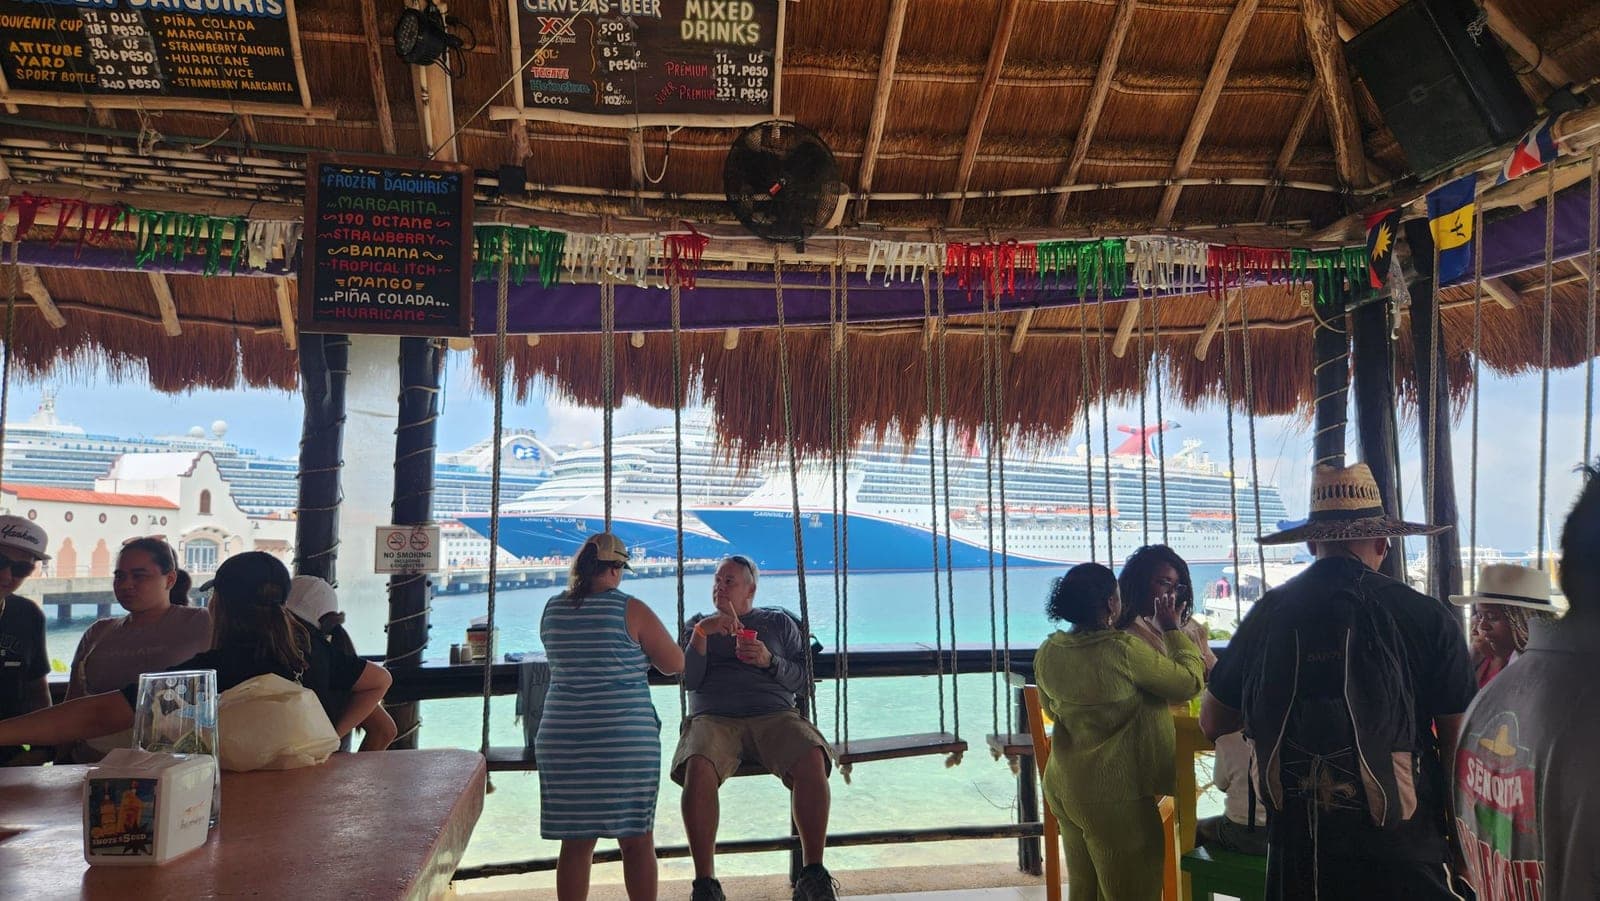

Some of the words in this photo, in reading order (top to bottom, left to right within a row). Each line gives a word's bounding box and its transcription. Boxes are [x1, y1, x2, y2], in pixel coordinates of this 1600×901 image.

[685, 0, 754, 20] MIXED
[0, 15, 56, 30] OUVENIR
[60, 19, 84, 32] CUP
[163, 14, 196, 28] PIÑA
[202, 18, 256, 31] COLADA
[537, 17, 576, 35] XX
[167, 29, 247, 42] MARGARITA
[617, 33, 631, 42] US
[681, 20, 760, 44] DRINKS
[122, 39, 139, 49] US
[168, 41, 238, 54] STRAWBERRY
[240, 46, 285, 57] DAIQUIRI
[92, 49, 119, 60] 306
[171, 54, 250, 67] HURRICANE
[716, 53, 732, 64] 11.
[748, 53, 764, 63] US
[15, 55, 65, 68] YARD
[131, 65, 148, 75] US
[178, 66, 218, 77] MIAMI
[224, 68, 255, 79] VICE
[531, 67, 569, 79] TECATE
[664, 61, 708, 76] PREMIUM
[16, 68, 57, 81] SPORT
[61, 72, 97, 84] BOTTLE
[716, 77, 732, 87] 13.
[747, 78, 763, 87] US
[101, 78, 125, 89] 340
[178, 78, 238, 90] STRAWBERRY
[241, 80, 294, 92] MARGARITA
[533, 92, 568, 104] Coors
[680, 85, 717, 99] PREMIUM
[716, 88, 736, 98] 221
[327, 174, 376, 190] FROZEN
[384, 178, 449, 194] DAIQUIRIS
[338, 196, 437, 214] MARGARITA
[337, 213, 364, 225] 190
[331, 258, 399, 273] TROPICAL
[404, 263, 436, 275] ITCH
[378, 293, 434, 306] COLADA
[384, 551, 394, 559] NO
[397, 551, 432, 559] SMOKING
